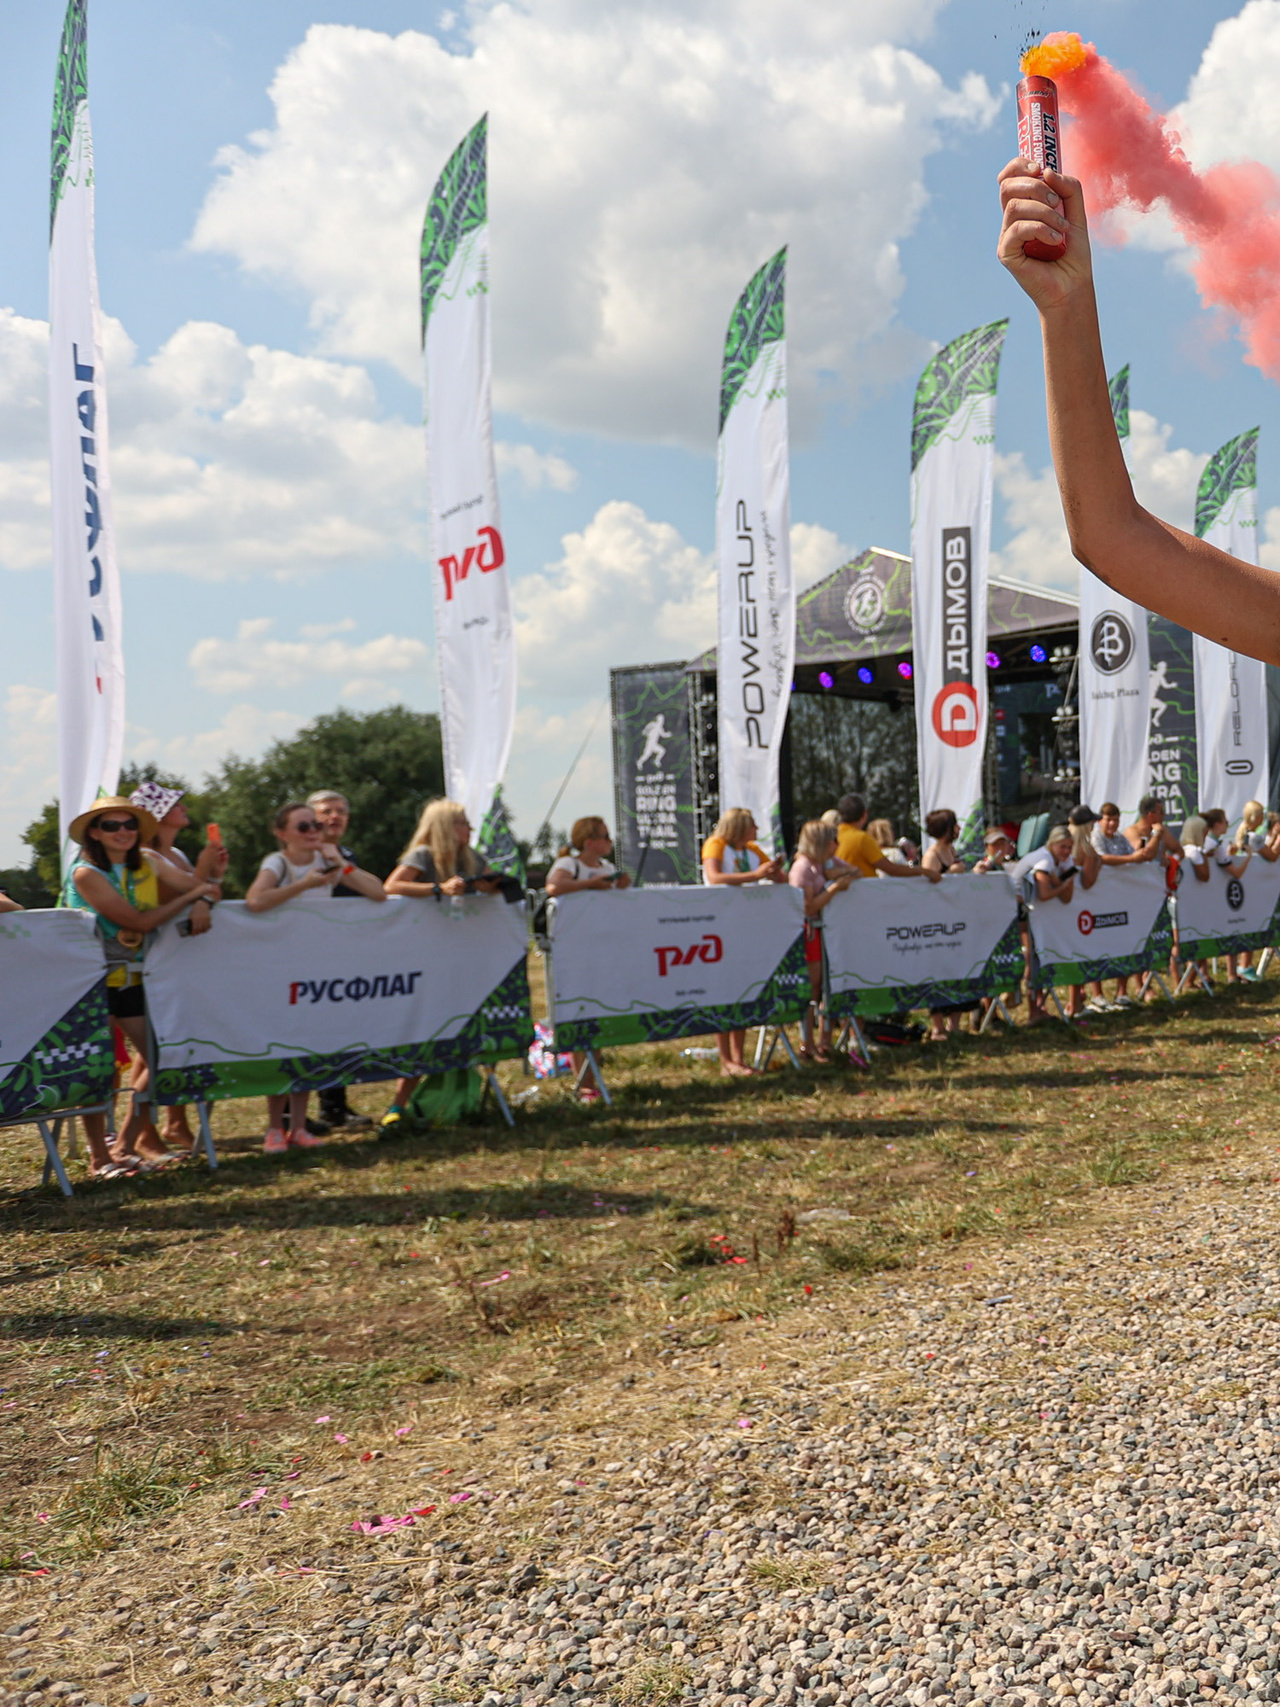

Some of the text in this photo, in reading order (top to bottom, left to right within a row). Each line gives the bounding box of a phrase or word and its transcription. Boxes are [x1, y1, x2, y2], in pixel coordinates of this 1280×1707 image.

[1030, 102, 1043, 141] SMOKING
[1043, 112, 1056, 133] 1.2
[945, 535, 970, 675] ДЫМОВ
[736, 499, 769, 750] POWERUP
[886, 922, 967, 940] POWERUP
[1093, 913, 1127, 927] ДЫМОВ
[288, 970, 423, 1006] РУСФЛАГ
